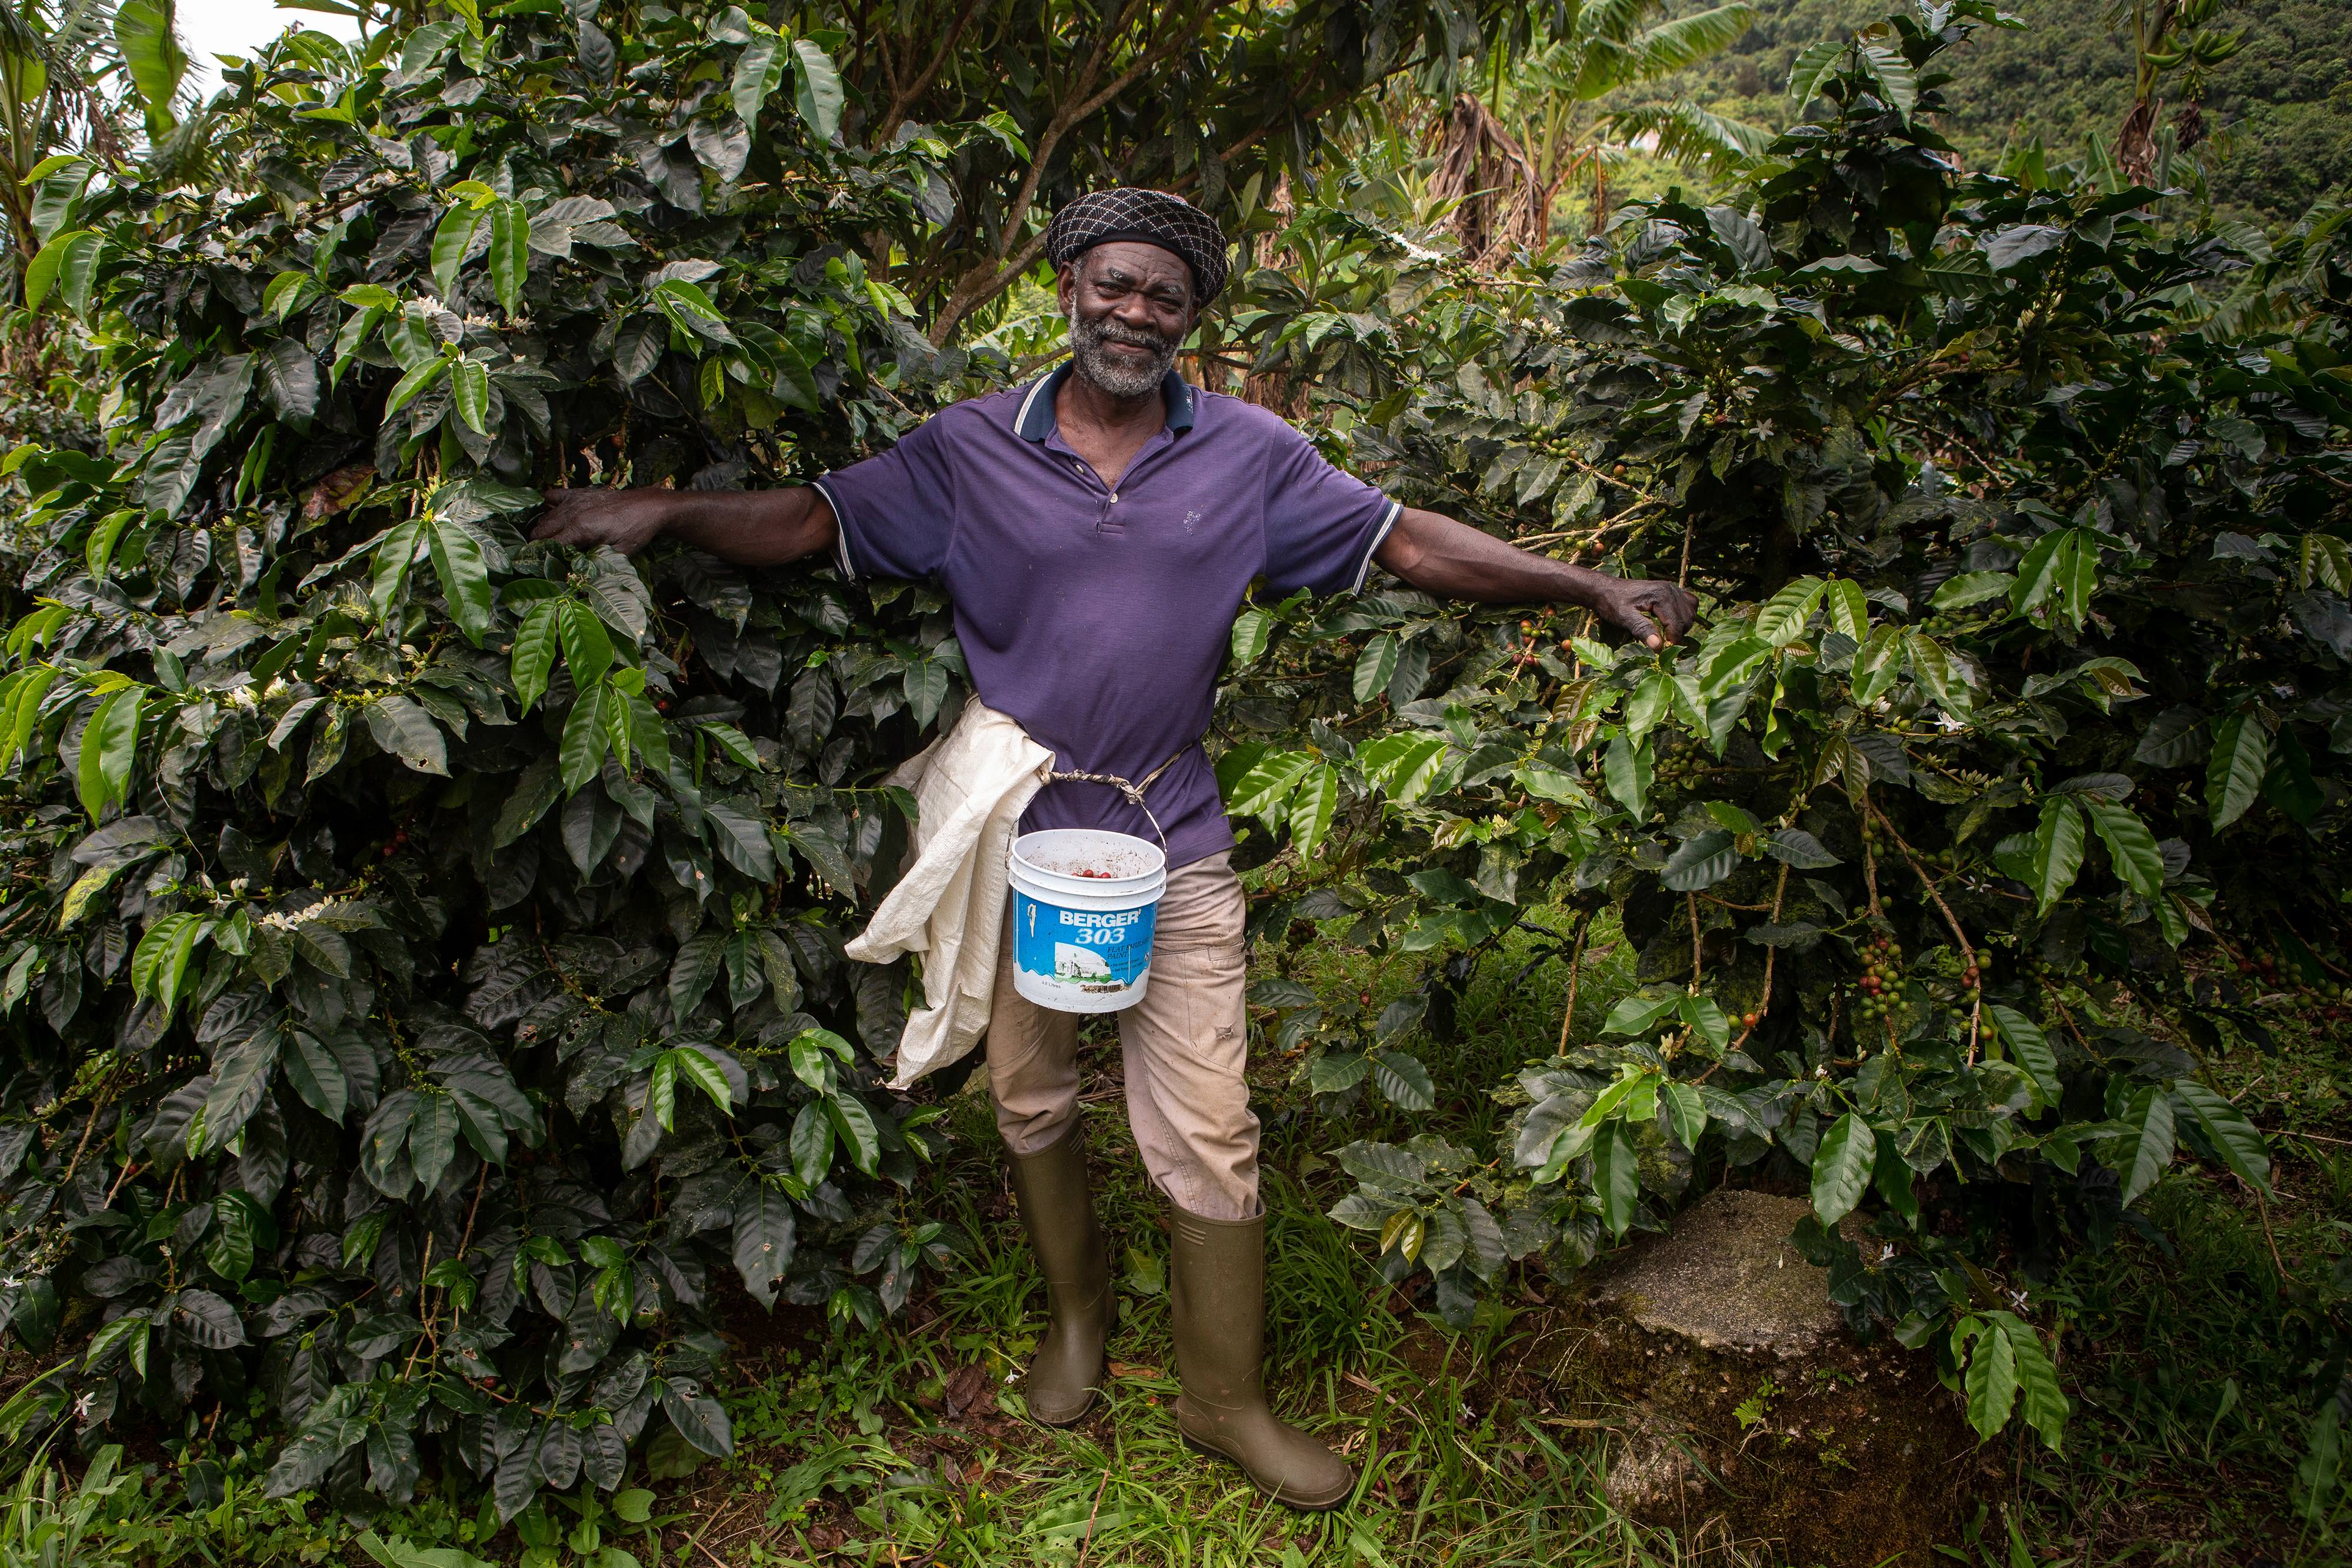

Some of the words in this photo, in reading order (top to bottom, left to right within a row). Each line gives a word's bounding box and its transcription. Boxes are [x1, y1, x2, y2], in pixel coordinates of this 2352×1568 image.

[1060, 910, 1139, 928] BERGER
[1074, 927, 1125, 945] 303
[1107, 945, 1125, 953] FLAT
[1107, 951, 1128, 959] PAINT
